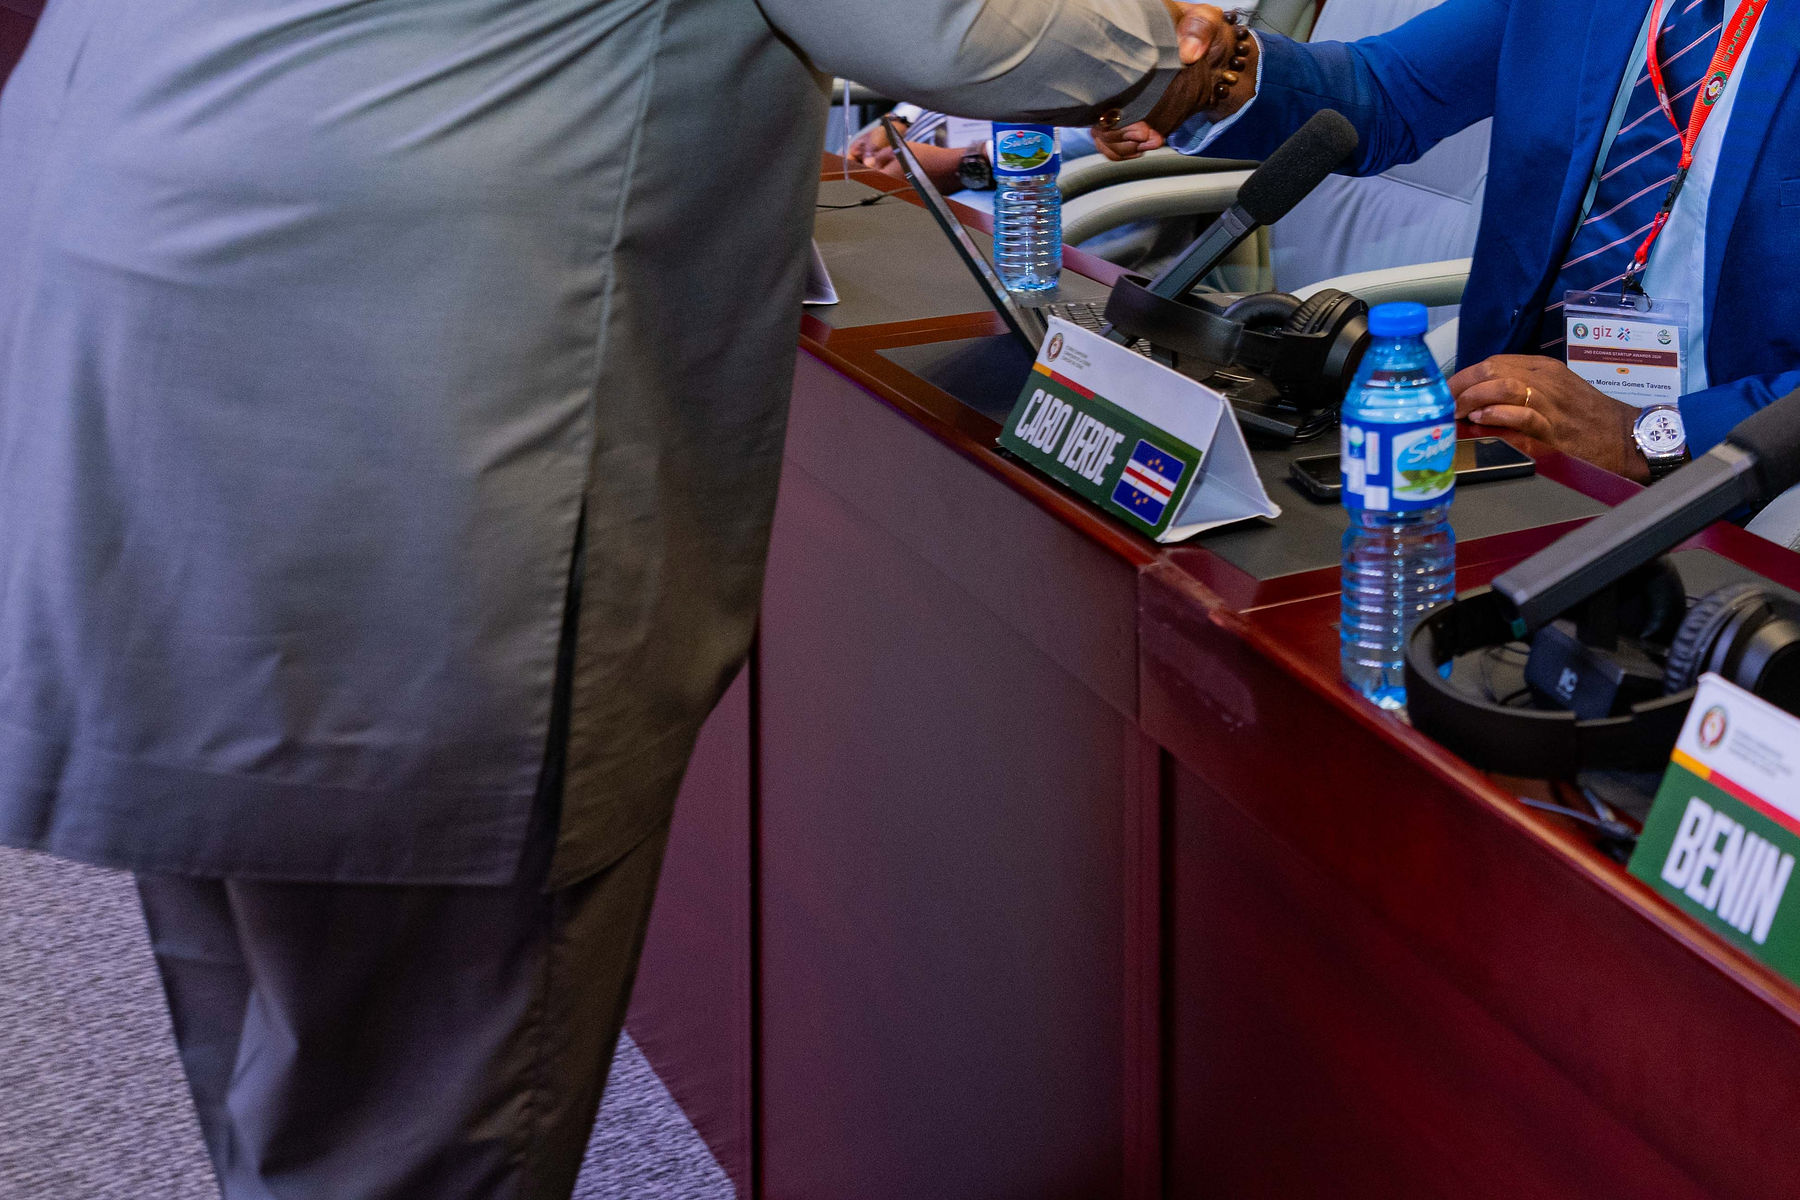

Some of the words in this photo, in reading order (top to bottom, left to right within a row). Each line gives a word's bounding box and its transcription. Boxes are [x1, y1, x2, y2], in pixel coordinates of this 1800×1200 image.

[1724, 5, 1755, 62] Awards
[1592, 325, 1612, 340] giz
[1596, 379, 1620, 387] Moreira
[1621, 380, 1645, 388] Gomes
[1014, 388, 1074, 455] CABO
[1056, 411, 1126, 486] VERDE
[1660, 796, 1796, 945] BENIN
